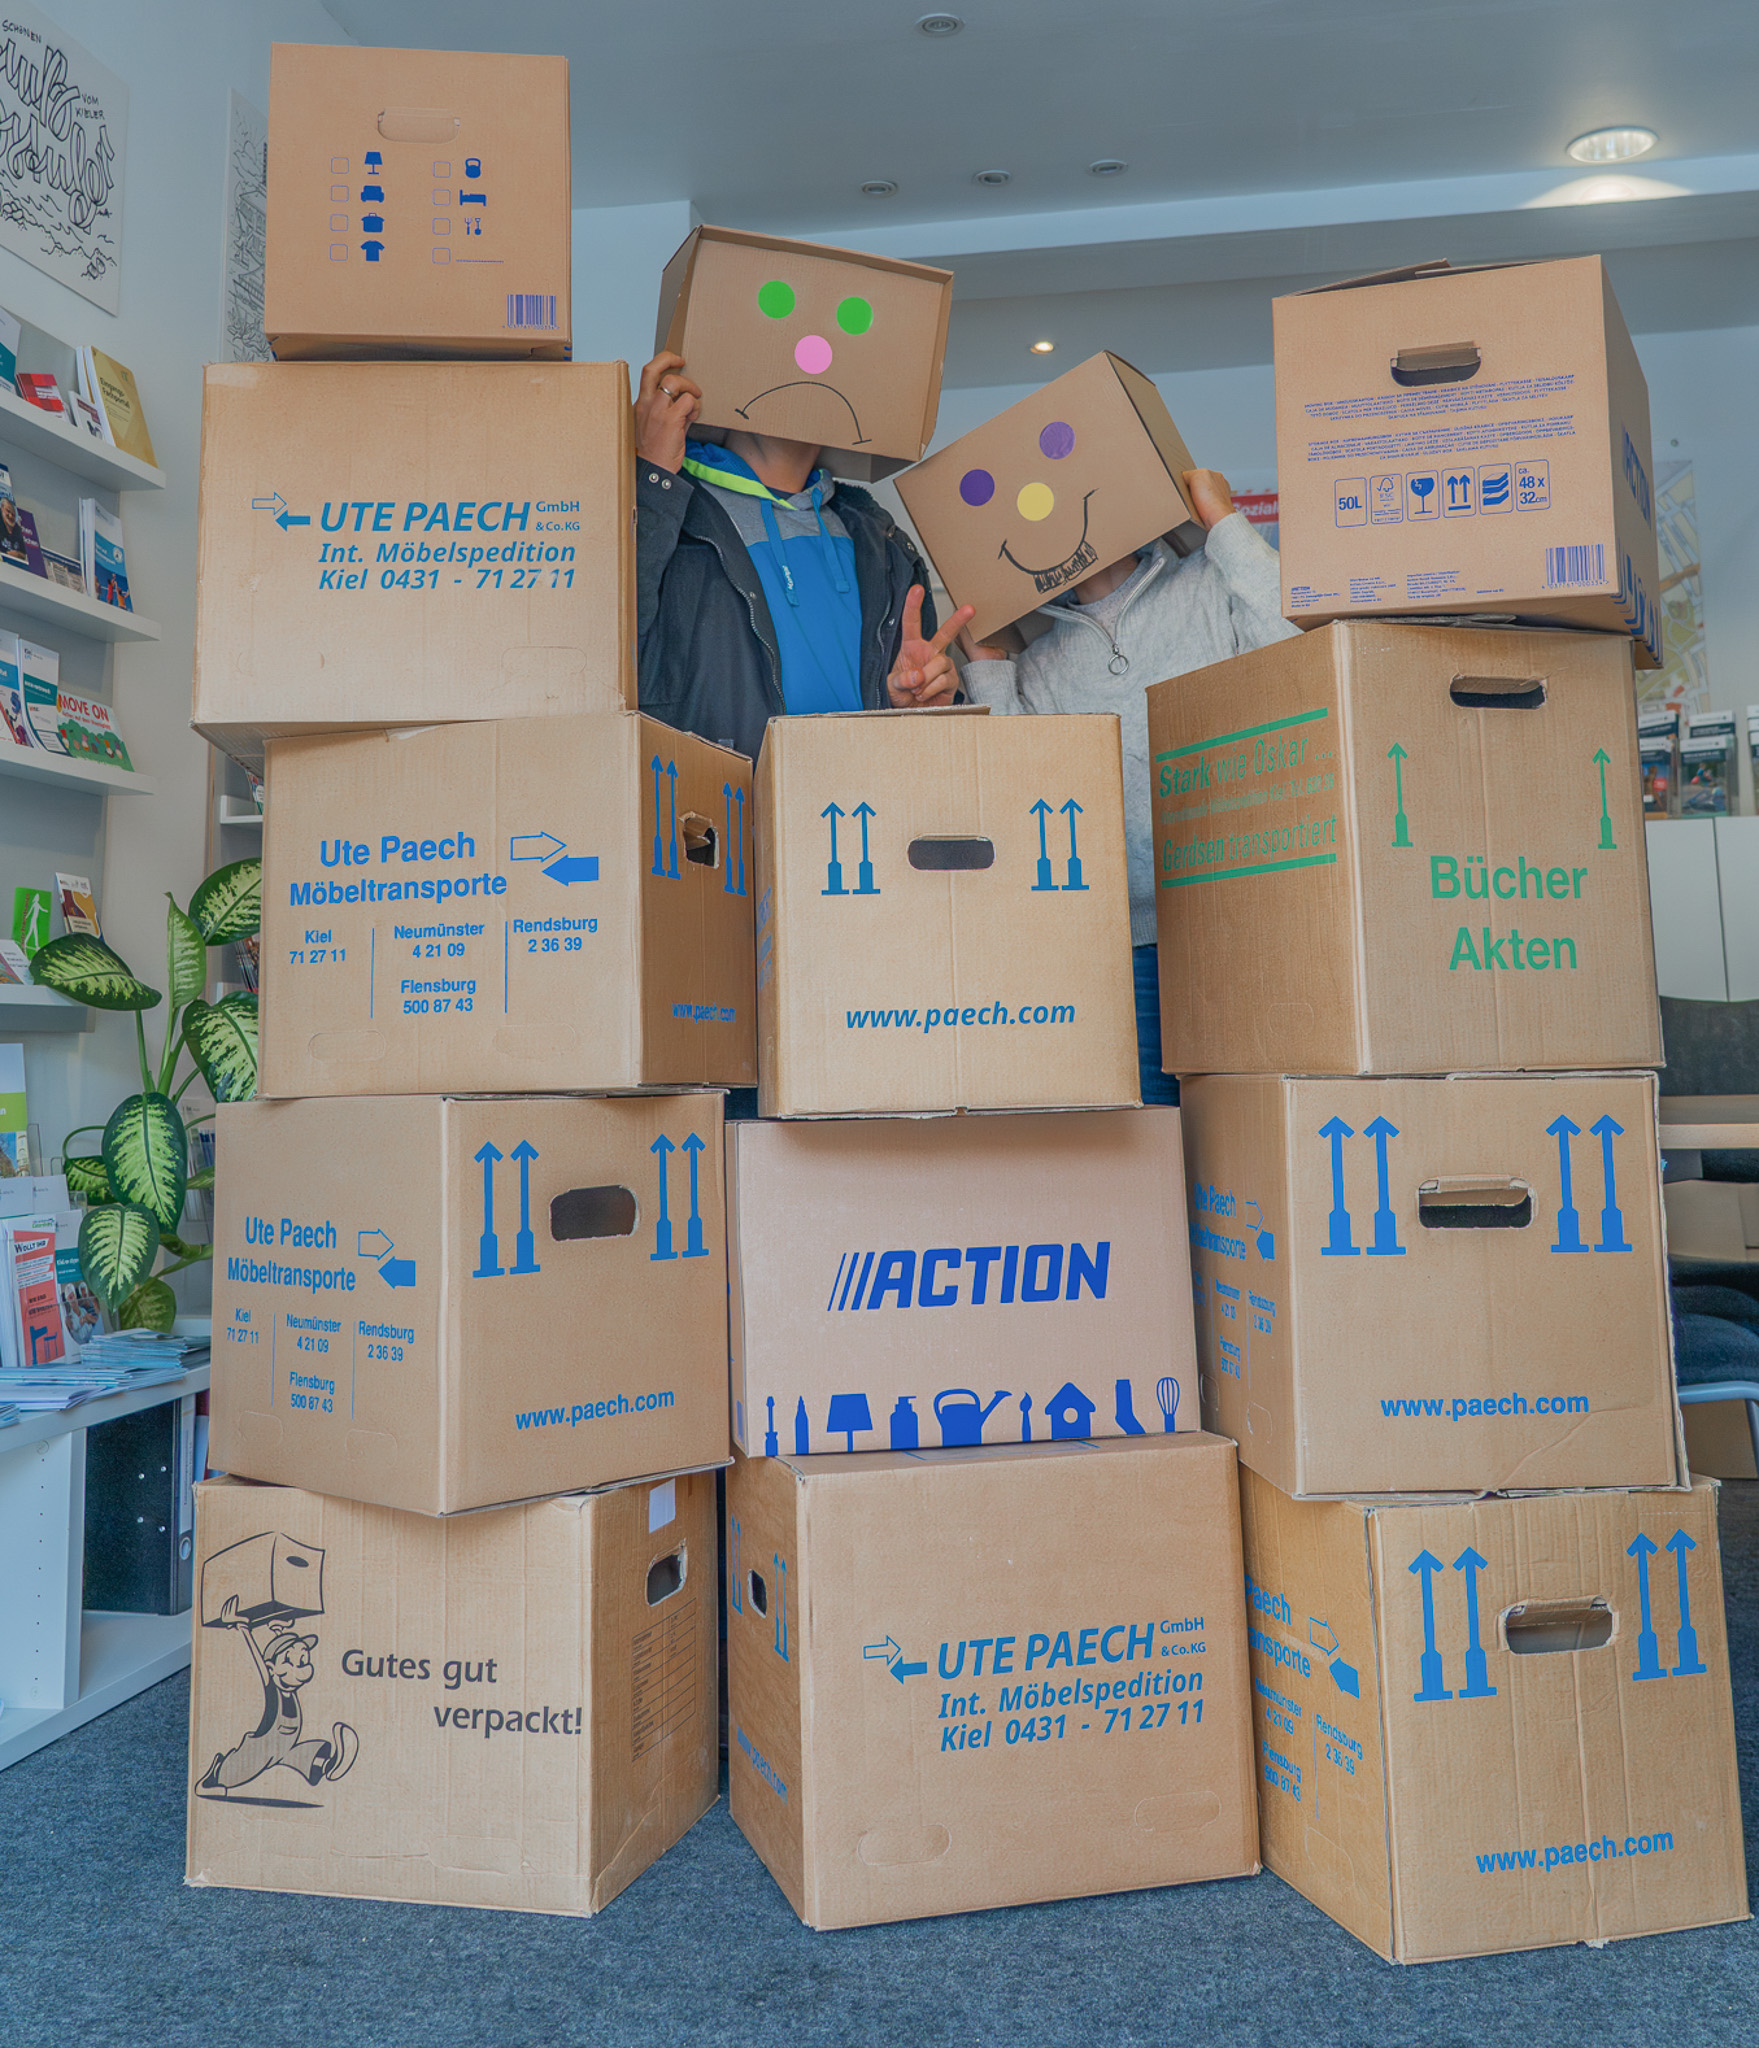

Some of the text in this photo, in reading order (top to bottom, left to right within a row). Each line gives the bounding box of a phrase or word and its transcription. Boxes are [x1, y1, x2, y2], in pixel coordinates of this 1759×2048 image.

[1518, 467, 1530, 475] ca.
[1519, 476, 1545, 489] 48 x
[320, 502, 531, 532] UTE PAECH
[536, 500, 580, 515] GmbH
[1338, 496, 1362, 510] 50L
[318, 541, 576, 569] Int. Möbelspedition
[319, 568, 368, 590] Kiel
[381, 569, 439, 590] 0431
[91, 704, 109, 723] ON
[1159, 755, 1210, 798] Stark
[1217, 746, 1246, 784] wie
[1254, 735, 1308, 775] Oskar
[320, 831, 476, 867] Ute Paech
[1163, 814, 1337, 871] Gerdsen transportiert
[290, 871, 507, 906] Möbeltransporte
[1430, 855, 1588, 900] Bücher
[304, 928, 332, 944] Kiel
[394, 922, 485, 941] Neumünster
[513, 916, 598, 935] Rendsburg
[289, 949, 347, 964] 71 27 11
[412, 942, 465, 959] 4 21 09
[528, 937, 582, 953] 2 36 39
[1448, 926, 1578, 970] Akten
[400, 977, 476, 996] Flensburg
[403, 997, 474, 1014] 500 87 43
[846, 1001, 1076, 1033] www.paech.com
[1209, 1184, 1236, 1218] Paech
[245, 1216, 337, 1249] Ute Paech
[227, 1257, 356, 1294] Möbeltransporte
[867, 1241, 1110, 1310] ACTION
[235, 1307, 251, 1323] Kiel
[286, 1313, 342, 1333] Neumünster
[237, 1328, 249, 1343] 27
[304, 1337, 315, 1351] 21
[358, 1320, 415, 1344] Rendsburg
[368, 1344, 404, 1362] 2 36 39
[289, 1371, 335, 1395] Flensburg
[290, 1393, 333, 1413] 500 87 43
[515, 1391, 674, 1430] www.paech.com
[1380, 1392, 1589, 1422] www.paech.com
[1160, 1617, 1205, 1634] GmbH
[937, 1622, 1155, 1680] UTE PAECH
[341, 1649, 497, 1690] Gutes gut
[938, 1669, 1203, 1718] Int. Möbelspedition
[1255, 1676, 1302, 1718] Neumünster
[433, 1705, 582, 1739] verpackt!
[940, 1720, 991, 1752] Kiel
[1005, 1714, 1066, 1745] 0431
[1104, 1707, 1132, 1734] 71
[1139, 1703, 1170, 1730] 27
[1177, 1699, 1204, 1725] 11
[1316, 1713, 1363, 1760] Rendsburg
[1326, 1743, 1332, 1760] 2
[1344, 1754, 1355, 1776] 39
[1476, 1831, 1674, 1874] www.paech.com
